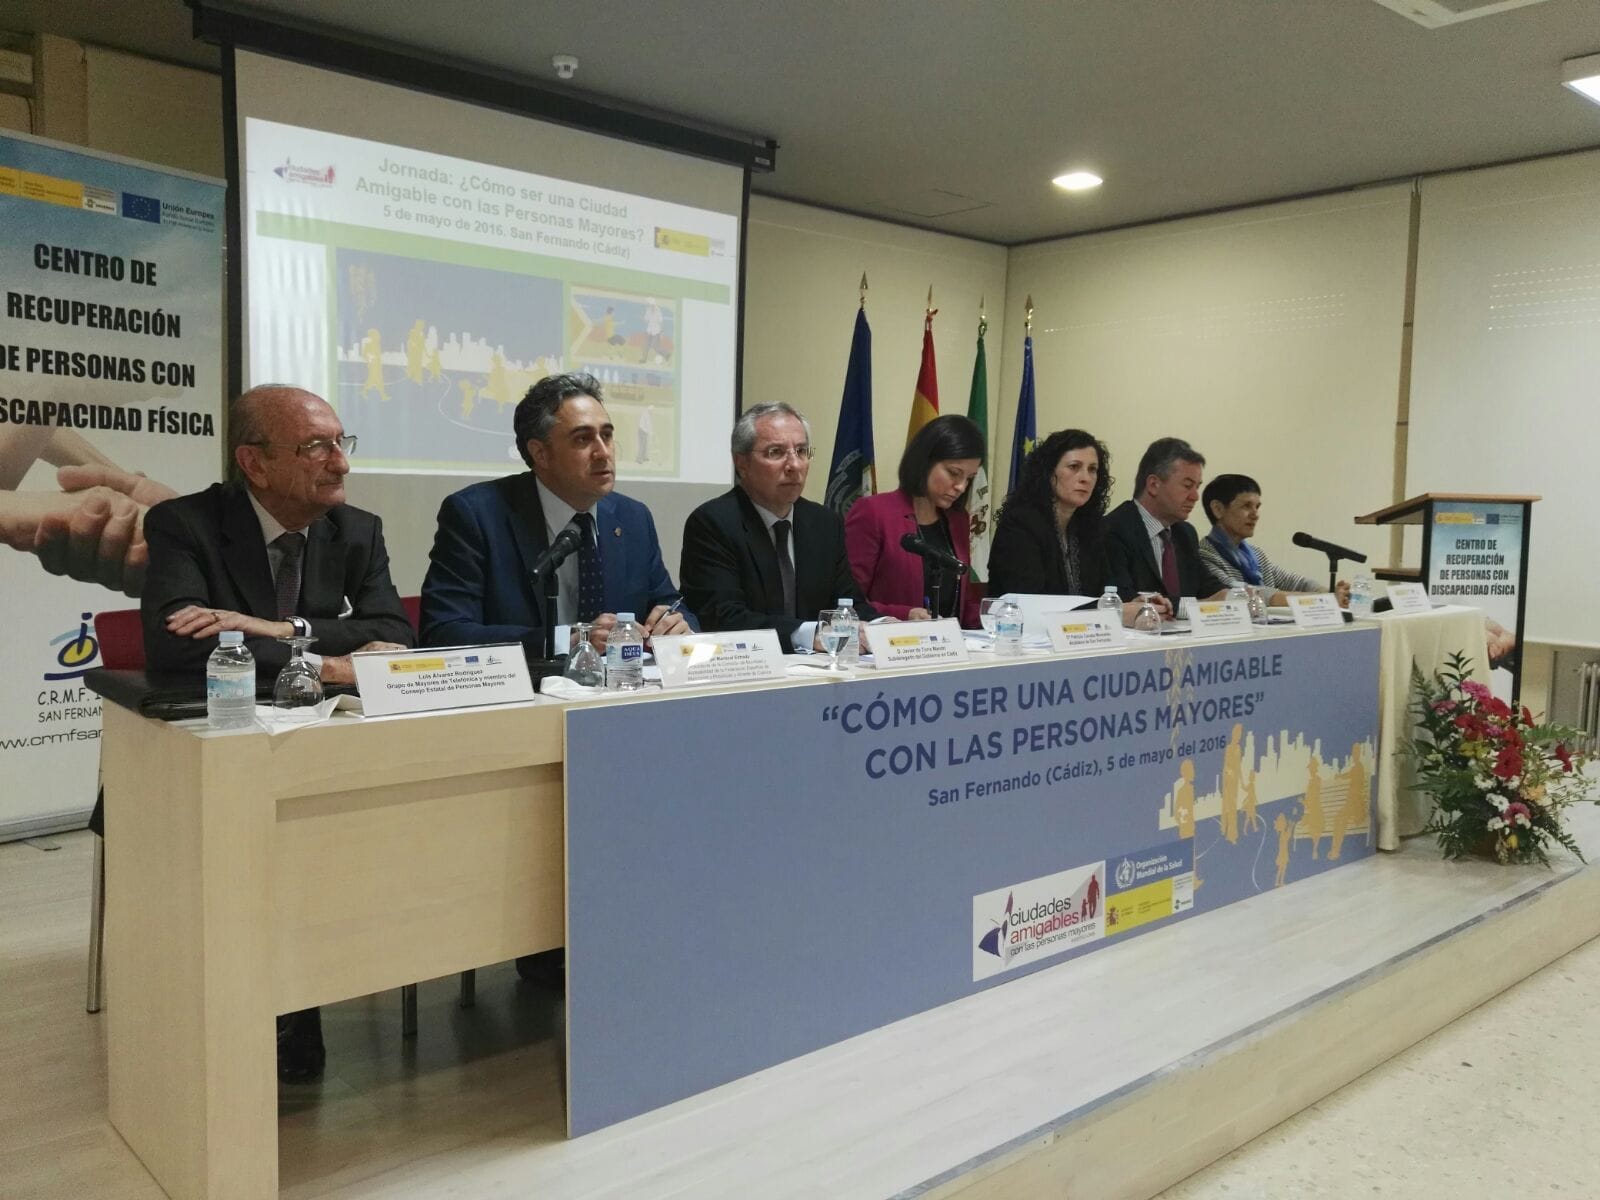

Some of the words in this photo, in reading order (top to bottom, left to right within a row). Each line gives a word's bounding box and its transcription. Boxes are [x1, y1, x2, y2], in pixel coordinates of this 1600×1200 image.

[378, 157, 453, 185] Jornada:
[459, 175, 516, 197] ¿Cómo
[520, 187, 543, 202] ser
[548, 194, 575, 209] una
[579, 198, 628, 218] Ciudad
[162, 201, 185, 213] Unión
[355, 176, 437, 204] Amigable
[442, 196, 472, 211] con
[478, 200, 500, 215] las
[505, 203, 574, 229] Personas
[578, 217, 644, 242] Mayores?
[383, 204, 391, 217] 5
[394, 208, 412, 221] de
[415, 211, 452, 228] mayo
[455, 218, 471, 231] de
[510, 226, 533, 241] San
[536, 231, 590, 251] Fernando
[592, 241, 631, 260] (Cádiz)
[34, 243, 125, 282] CENTRO
[130, 259, 157, 286] DE
[7, 291, 181, 338] RECUPERACIÓN
[26, 347, 146, 383] PERSONAS
[151, 361, 195, 388] CON
[148, 405, 214, 437] FÍSICA
[1446, 553, 1505, 565] RECUPERACIÓN
[1455, 538, 1485, 550] CENTRO
[1487, 539, 1497, 550] DE
[1431, 584, 1489, 595] DISCAPACIDAD
[1490, 583, 1515, 595] FÍSICA
[1440, 569, 1449, 580] DE
[1451, 569, 1491, 580] PERSONAS
[1492, 569, 1509, 580] CON
[822, 691, 943, 734] “CÓMO
[953, 686, 1008, 719] SER
[1017, 679, 1074, 710] UNA
[1083, 667, 1173, 701] CIUDAD
[1181, 654, 1283, 689] AMIGABLE
[38, 709, 62, 723] SAN
[865, 741, 936, 779] CON
[948, 731, 1003, 766] LAS
[1013, 709, 1147, 755] PERSONAS
[1155, 692, 1264, 731] MAYORES”
[928, 788, 959, 806] San
[965, 770, 1041, 799] Fernando
[1046, 759, 1102, 785] (Cádiz),
[1106, 757, 1114, 771] 5
[1119, 753, 1135, 768] de
[1139, 748, 1173, 770] mayo
[1177, 744, 1196, 760] del
[1199, 735, 1226, 754] 2016
[1010, 897, 1071, 926] ciudades
[1010, 911, 1079, 945] amigables
[1010, 945, 1024, 957] con
[1024, 941, 1036, 952] las
[1036, 931, 1067, 950] personas
[1067, 922, 1097, 938] mayores
